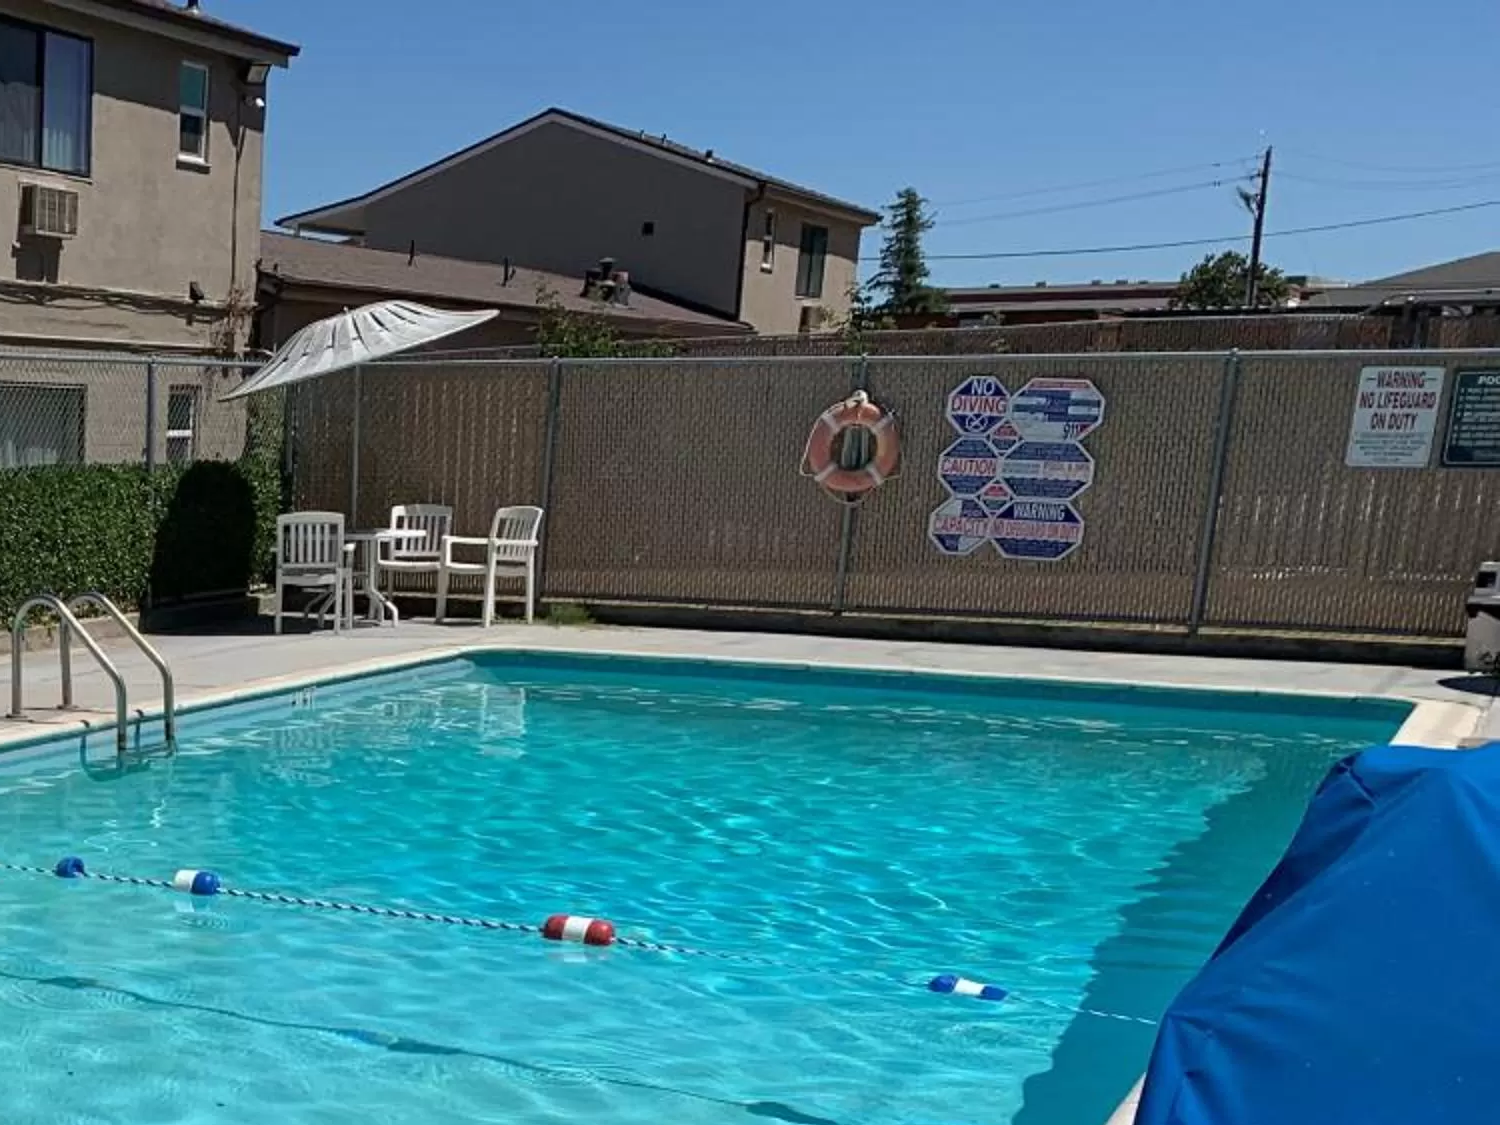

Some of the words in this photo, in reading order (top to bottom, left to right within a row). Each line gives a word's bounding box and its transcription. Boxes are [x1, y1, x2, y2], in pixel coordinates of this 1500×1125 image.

[971, 379, 995, 396] NO
[1376, 371, 1426, 389] WARNING
[951, 395, 1007, 414] DIVING
[1359, 391, 1375, 409] NO
[1377, 391, 1437, 409] LIFEGUARD
[1370, 412, 1385, 430] ON
[1387, 412, 1418, 430] DUTY
[942, 458, 997, 476] CAUTION
[1013, 503, 1066, 521] WARNING
